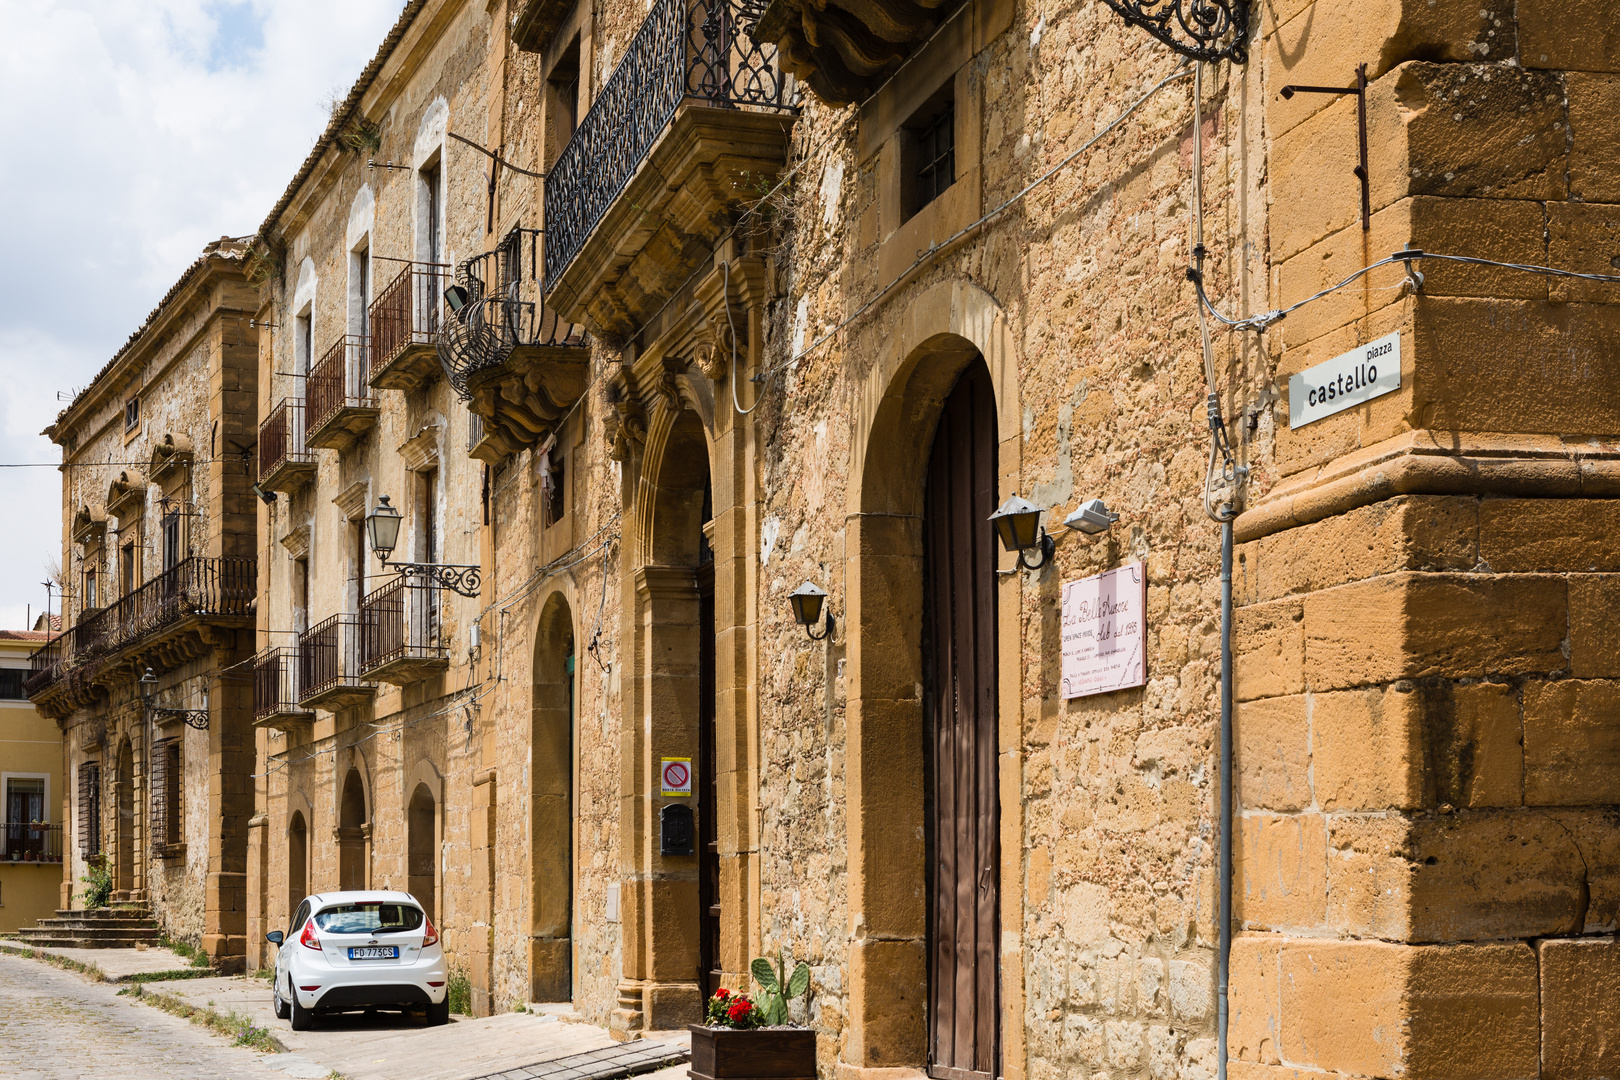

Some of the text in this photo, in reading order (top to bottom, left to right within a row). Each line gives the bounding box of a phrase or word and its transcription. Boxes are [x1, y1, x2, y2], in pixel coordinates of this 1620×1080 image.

[1367, 342, 1392, 362] piazza
[1309, 364, 1377, 407] castello
[1063, 605, 1076, 627] La
[1079, 596, 1101, 622] Belle
[354, 948, 364, 957] FD
